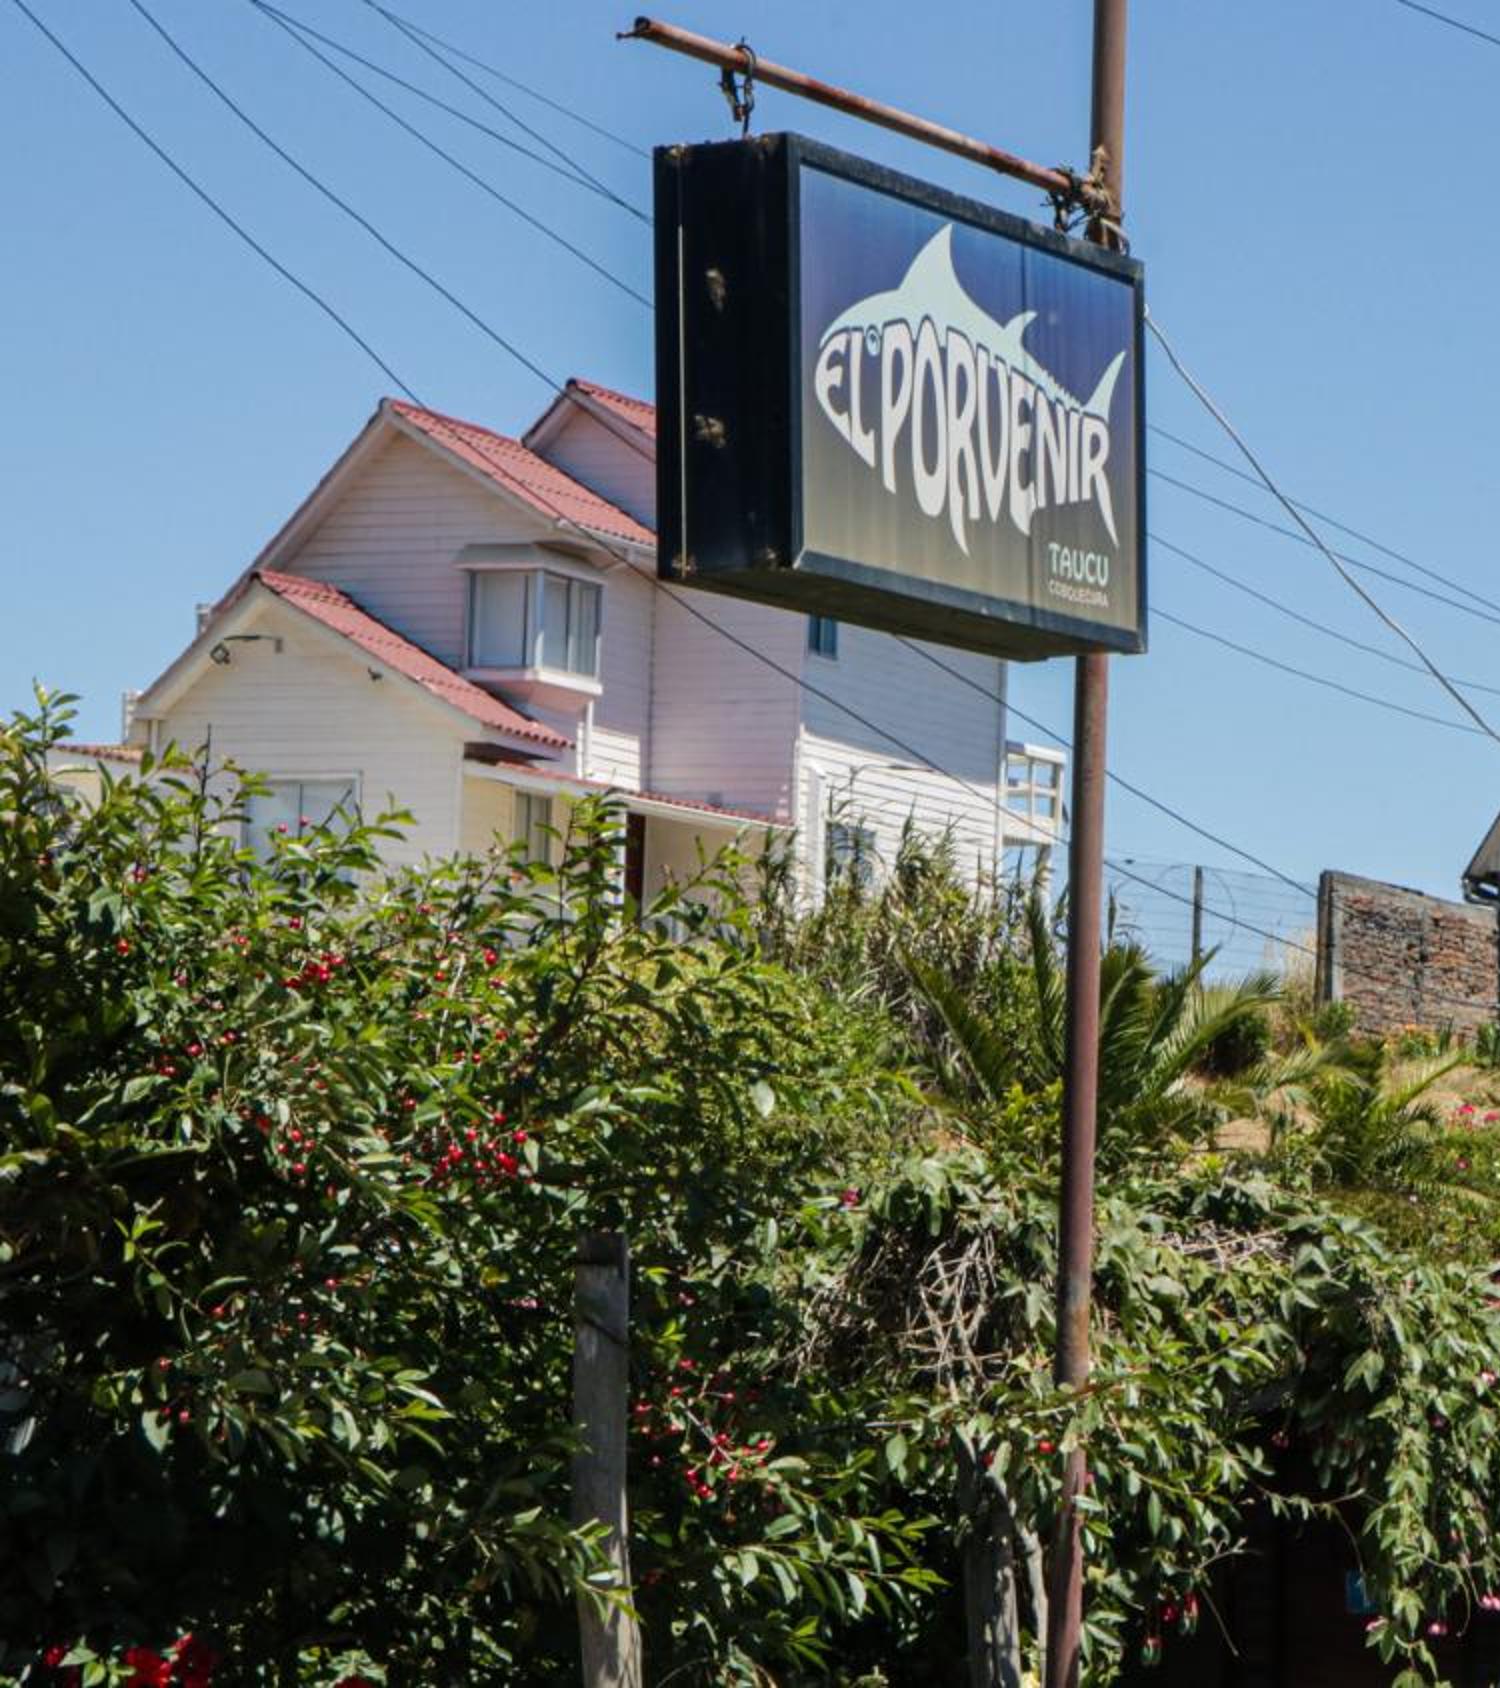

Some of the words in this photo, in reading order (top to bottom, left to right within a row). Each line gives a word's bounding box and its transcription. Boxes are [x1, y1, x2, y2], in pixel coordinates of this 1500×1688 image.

[815, 327, 875, 468] EL
[881, 315, 1119, 557] PORVENIR
[1048, 542, 1109, 588] TAUCU
